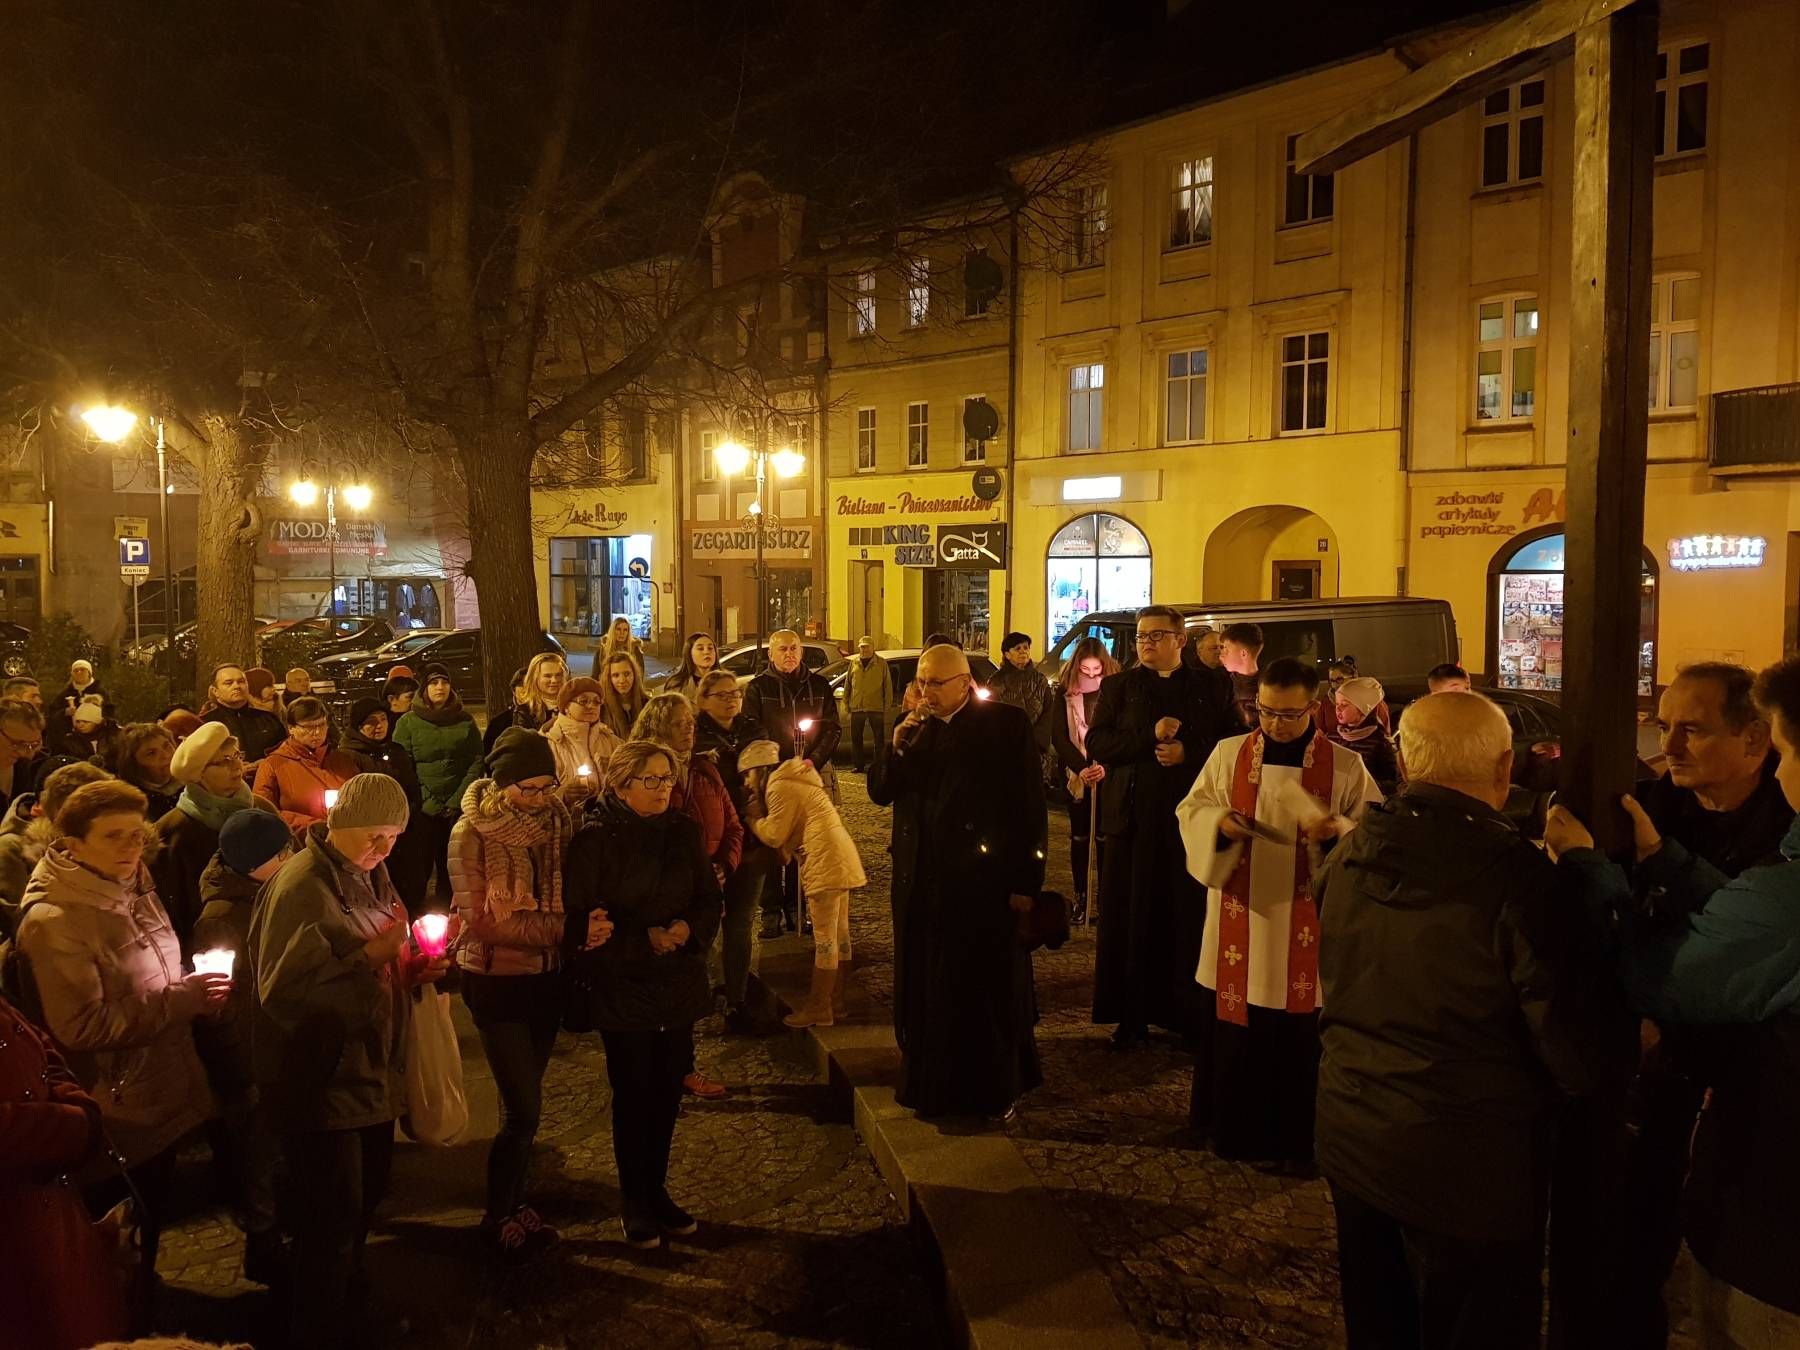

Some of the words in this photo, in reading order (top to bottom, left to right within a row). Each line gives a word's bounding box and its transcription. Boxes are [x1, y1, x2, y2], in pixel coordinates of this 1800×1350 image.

[836, 495, 885, 515] Bielizna
[1434, 490, 1504, 506] zabawki
[883, 524, 931, 545] KING
[1420, 522, 1517, 539] papiernicze
[895, 545, 935, 566] SIZE
[939, 533, 1000, 564] Gatta
